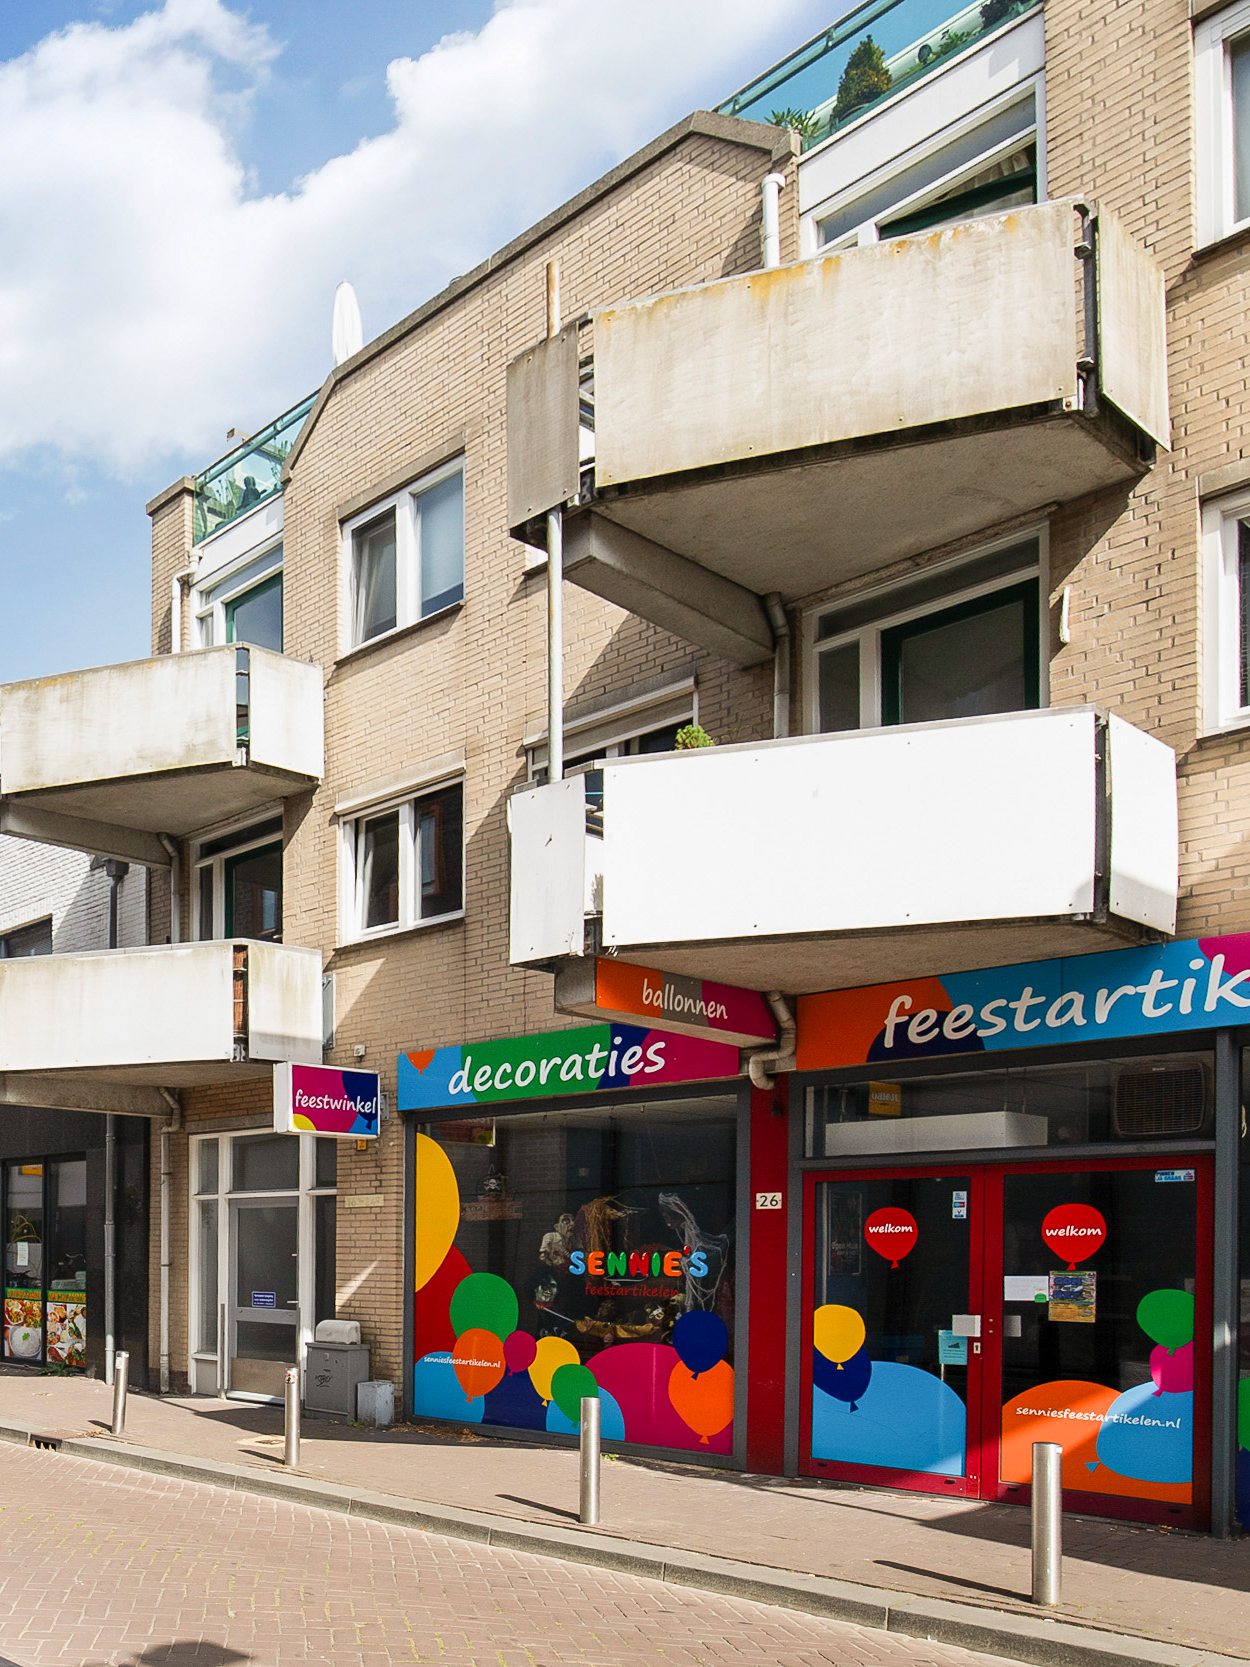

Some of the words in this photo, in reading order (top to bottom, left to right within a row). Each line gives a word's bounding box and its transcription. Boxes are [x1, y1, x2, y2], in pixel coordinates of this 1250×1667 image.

[642, 979, 728, 1020] ballonnen
[448, 1036, 666, 1095] decoraties
[295, 1088, 377, 1114] feestwinkel
[759, 1195, 779, 1207] 26
[868, 1223, 913, 1233] welkom
[1045, 1225, 1102, 1237] welkom
[568, 1245, 709, 1278] SENNIE'S
[584, 1283, 680, 1298] feestartikelen
[423, 1356, 501, 1368] senniesfeestartikelen.nl
[1015, 1406, 1181, 1429] senniesfeestartikelen.nl
